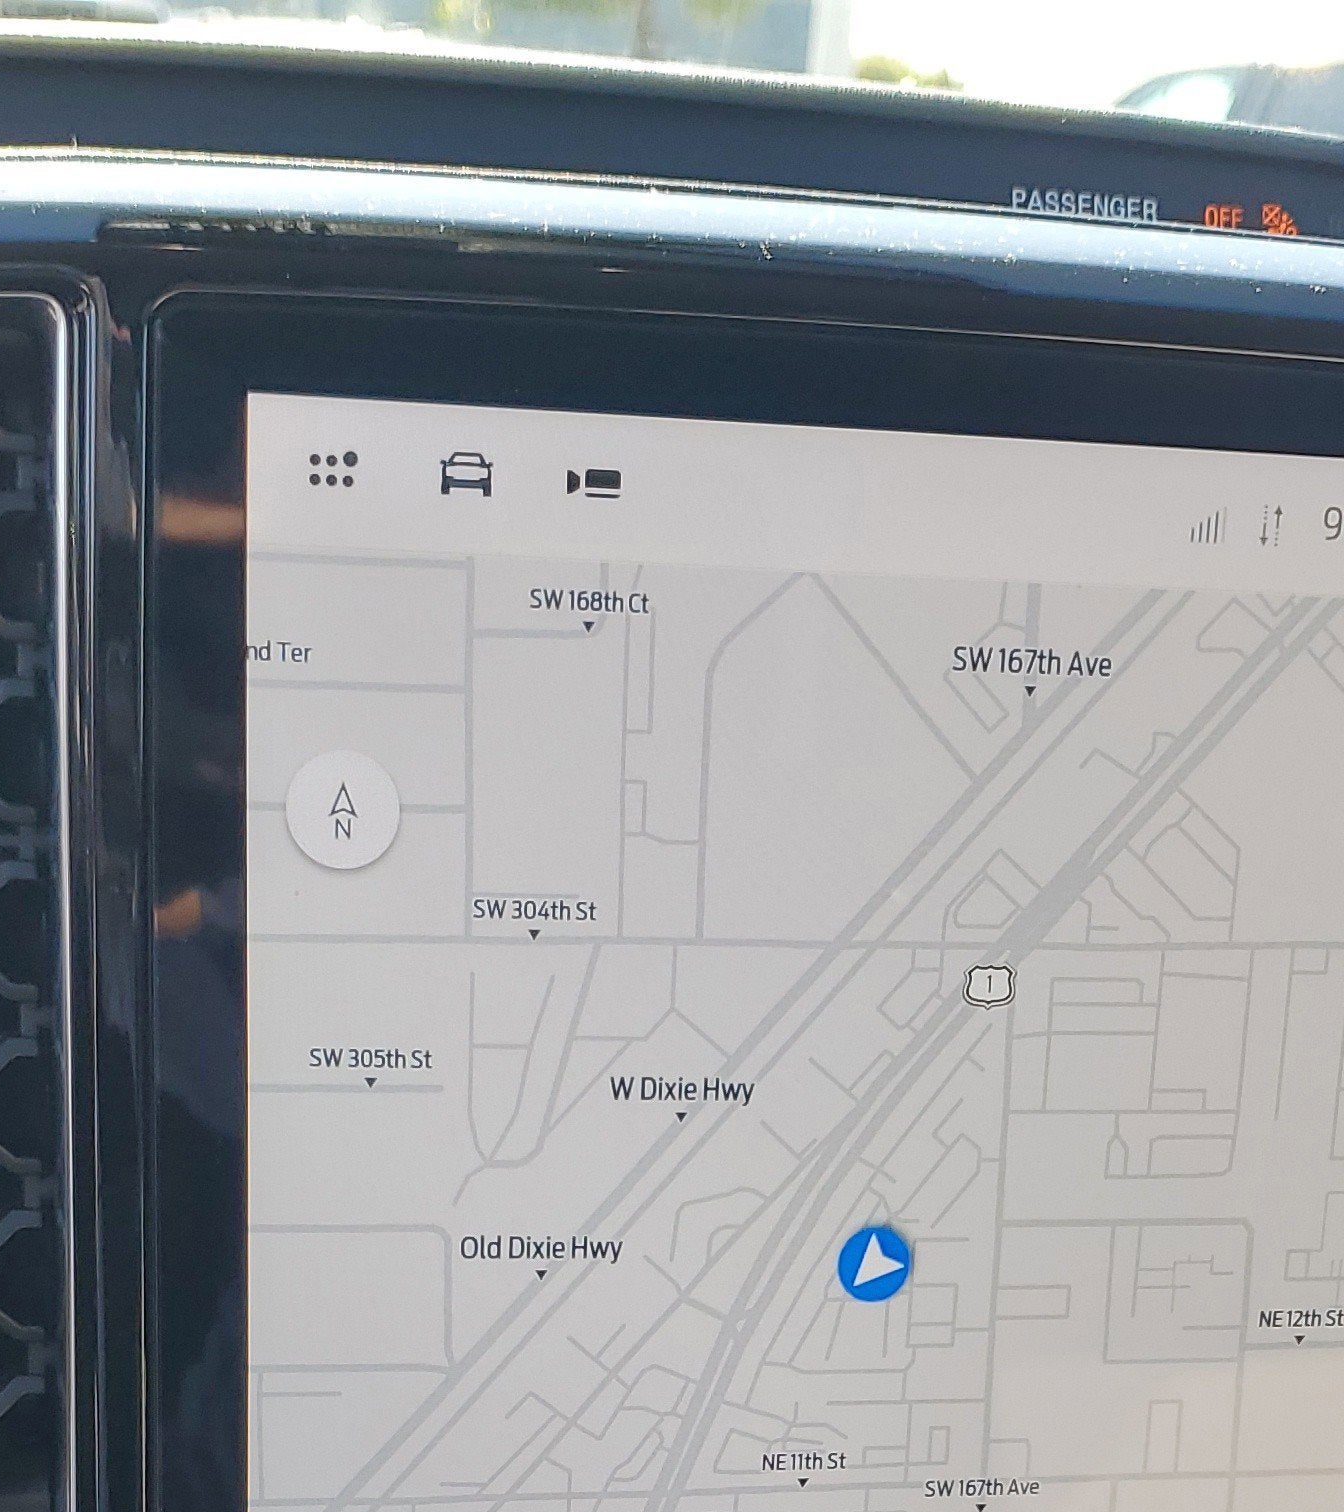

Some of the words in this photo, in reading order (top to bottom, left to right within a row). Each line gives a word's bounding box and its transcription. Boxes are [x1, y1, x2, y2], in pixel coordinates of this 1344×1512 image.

[1011, 187, 1157, 222] PASSENGER
[1204, 204, 1244, 229] OFF
[529, 588, 565, 611] SW
[568, 589, 625, 614] 168th
[627, 591, 650, 615] Ct
[276, 640, 313, 663] Ter
[951, 645, 994, 673] SW
[997, 646, 1062, 676] 167th
[1067, 652, 1113, 679] Ave
[334, 817, 353, 839] N
[471, 898, 508, 920] SW
[510, 898, 572, 922] 304th
[575, 899, 598, 922] St
[986, 974, 993, 994] 1
[308, 1047, 344, 1069] SW
[347, 1048, 407, 1070] 305th
[410, 1049, 433, 1071] St
[610, 1076, 636, 1101] W
[639, 1077, 698, 1102] Dixie
[702, 1079, 756, 1107] Hwy
[459, 1235, 502, 1260] Old
[507, 1235, 566, 1261] Dixie
[570, 1236, 623, 1263] Hwy
[1258, 1310, 1283, 1328] NE
[1285, 1309, 1322, 1328] 12th
[1325, 1309, 1344, 1327] St
[761, 1453, 787, 1472] NE
[790, 1452, 824, 1471] 11th
[825, 1451, 847, 1470] St
[924, 1480, 955, 1498] SW
[957, 1479, 1004, 1497] 167th
[1006, 1479, 1040, 1497] Ave
